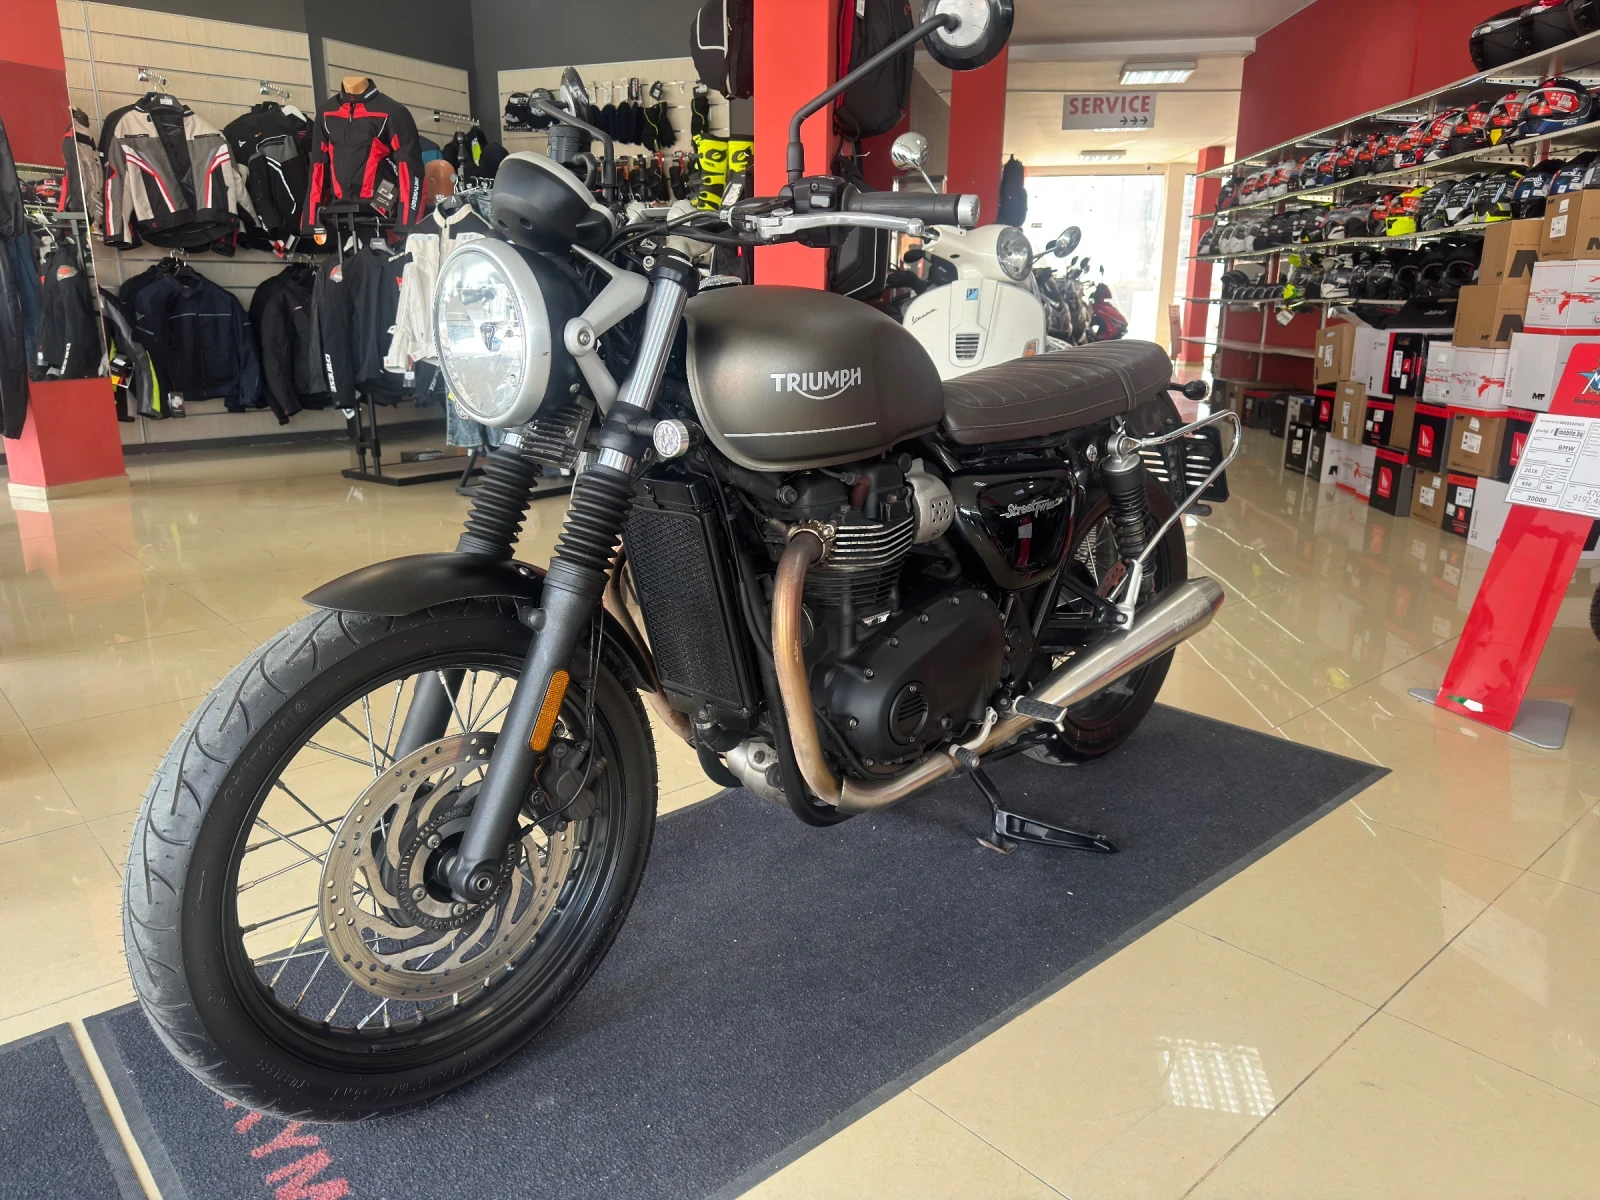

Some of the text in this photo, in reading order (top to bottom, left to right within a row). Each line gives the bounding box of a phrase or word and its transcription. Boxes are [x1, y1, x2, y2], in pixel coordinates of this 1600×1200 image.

[1069, 95, 1151, 115] SERVICE
[770, 367, 862, 400] TRIUMPH
[1532, 393, 1546, 401] MT
